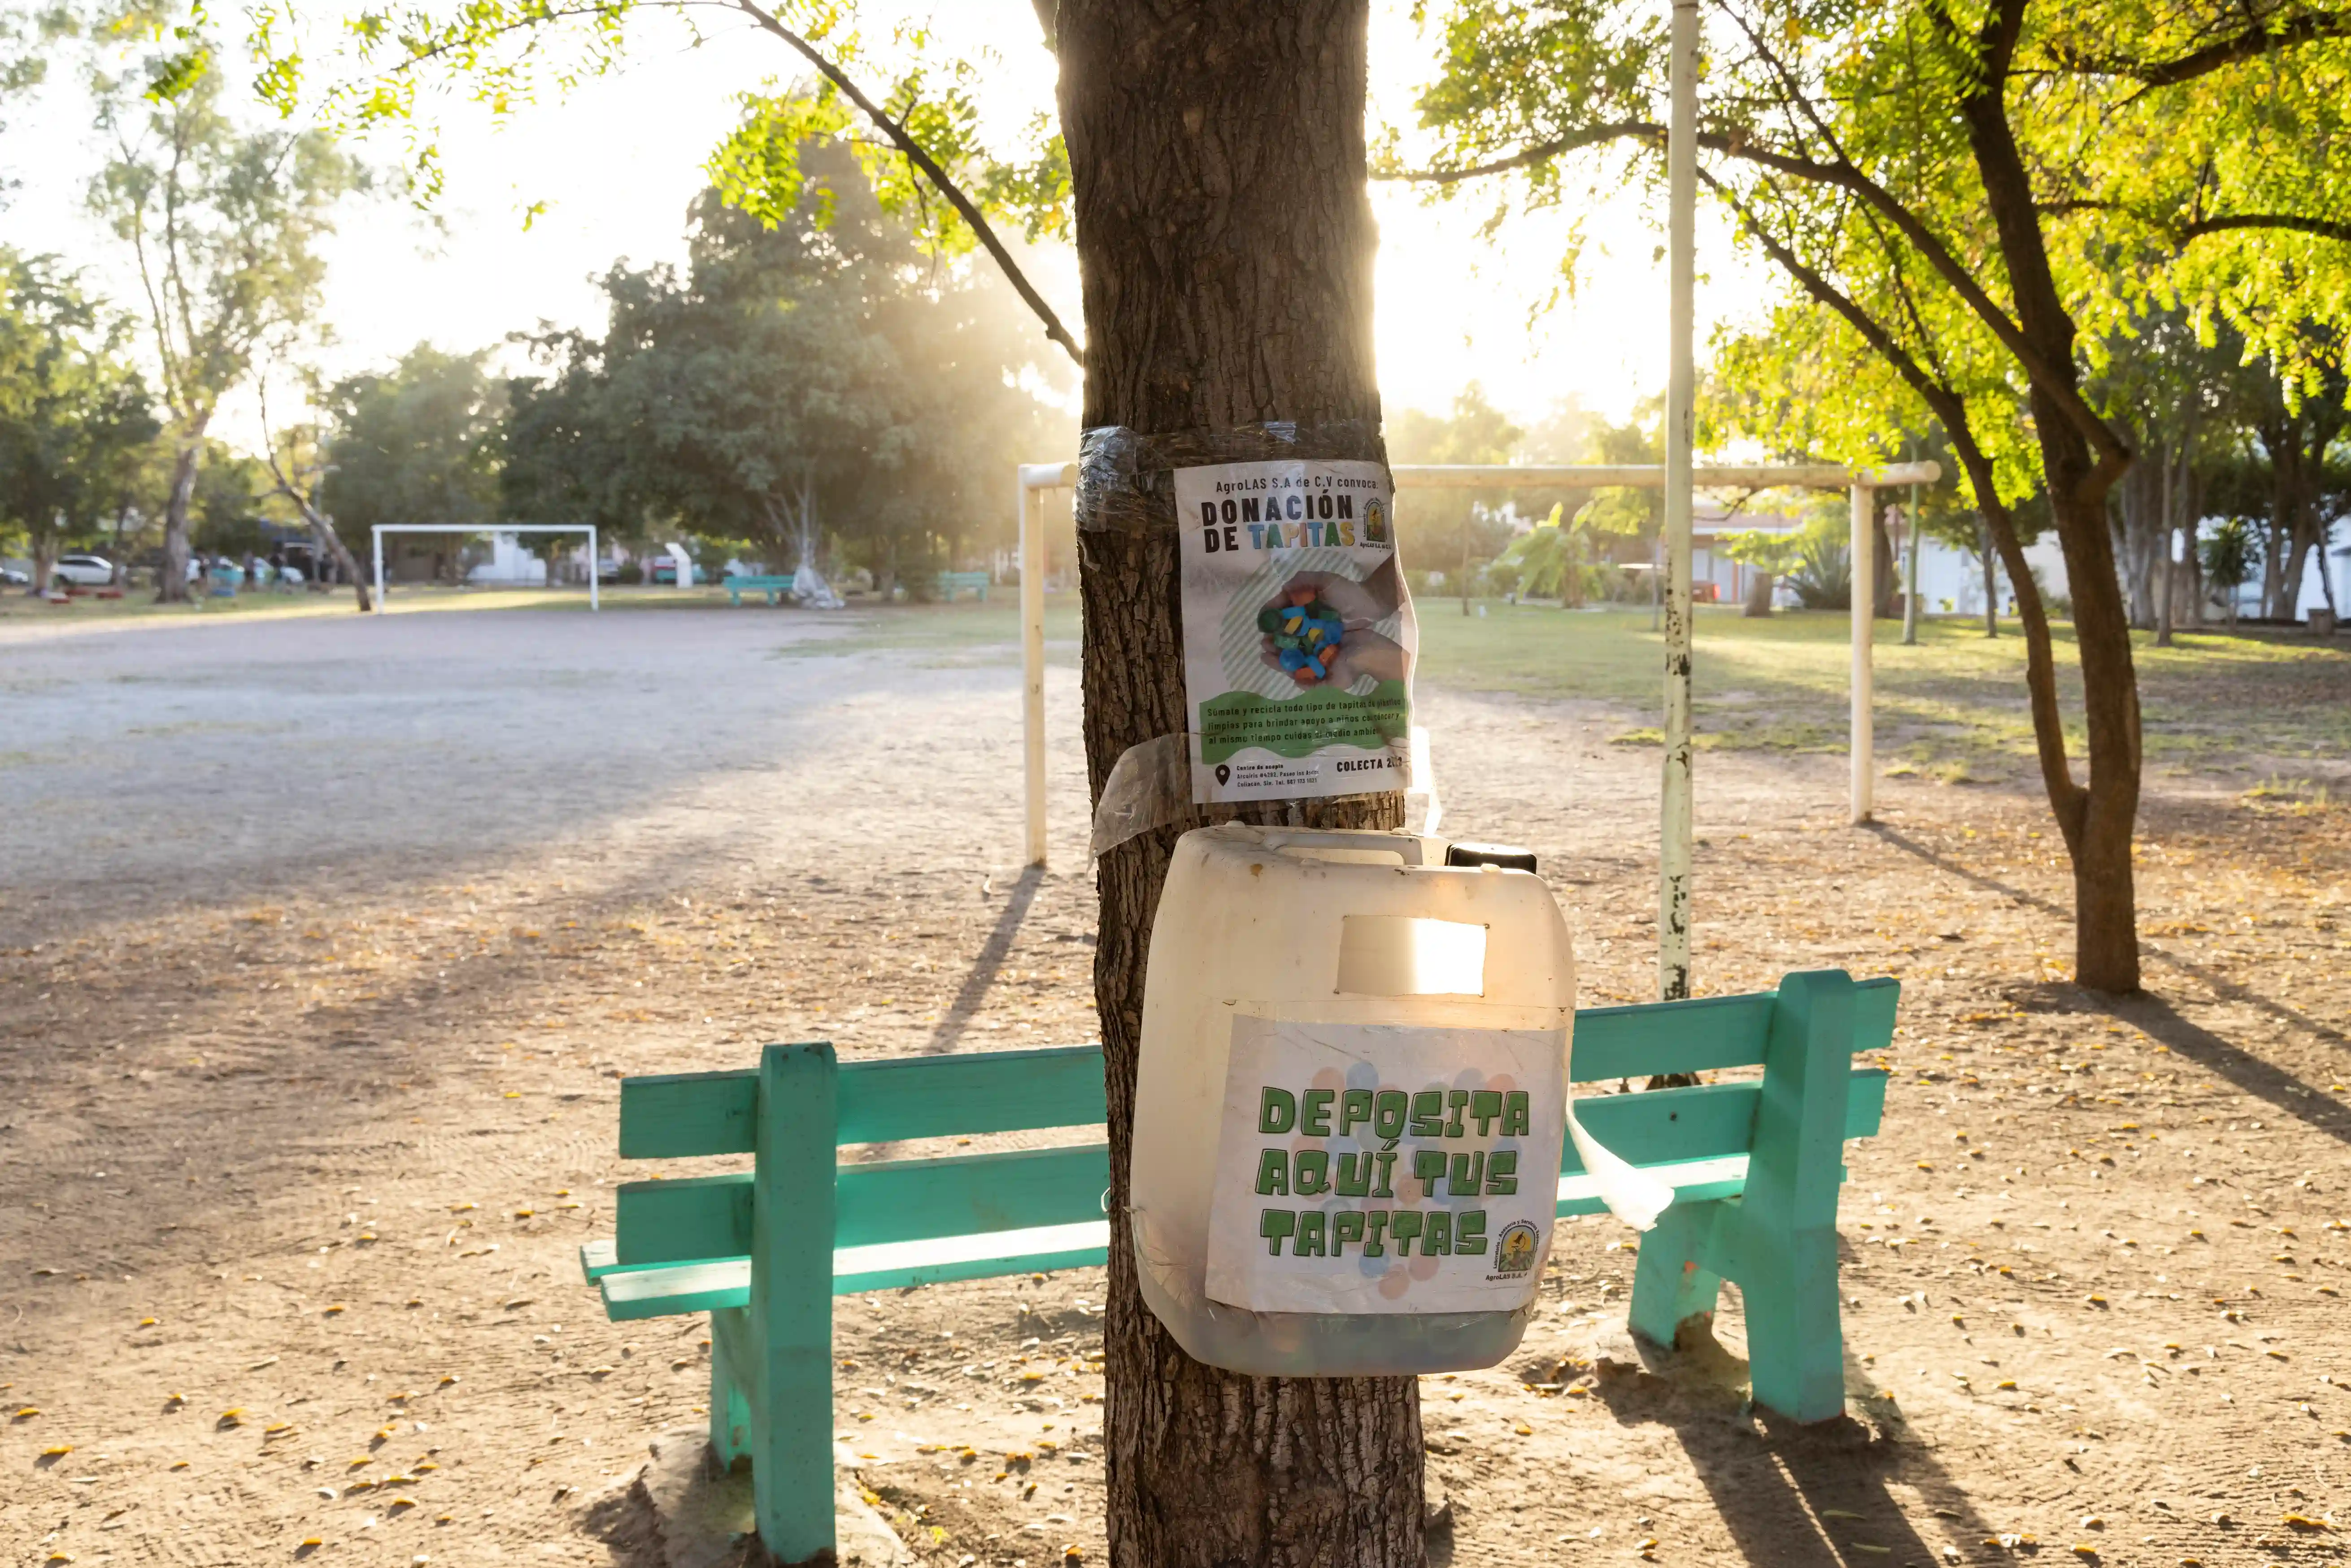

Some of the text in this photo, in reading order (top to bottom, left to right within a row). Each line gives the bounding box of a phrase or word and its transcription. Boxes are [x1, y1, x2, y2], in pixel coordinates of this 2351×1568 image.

[1216, 478, 1267, 494] AgroLAS
[1296, 477, 1310, 487] de
[1315, 476, 1332, 487] C.V
[1201, 489, 1353, 526] DONACIÓN
[1204, 521, 1355, 553] DE TAPITAS
[1208, 708, 1239, 717] Súmate
[1251, 705, 1281, 714] recicla
[1285, 704, 1302, 712] todo
[1306, 703, 1323, 712] tipo
[1326, 702, 1335, 710] de
[1339, 701, 1367, 711] tapitas
[1208, 721, 1240, 732] limpias
[1243, 721, 1263, 730] para
[1267, 719, 1297, 727] brindar
[1301, 717, 1325, 727] apoyo
[1337, 715, 1359, 723] niños
[1220, 735, 1248, 744] mismo
[1251, 733, 1281, 743] tiempo
[1284, 731, 1311, 740] cuidas
[1337, 758, 1383, 772] COLECTA
[1258, 1086, 1529, 1139] DEPOSITA
[1255, 1139, 1518, 1197] AQUÍ TUS
[1260, 1208, 1487, 1257] TAPITAS
